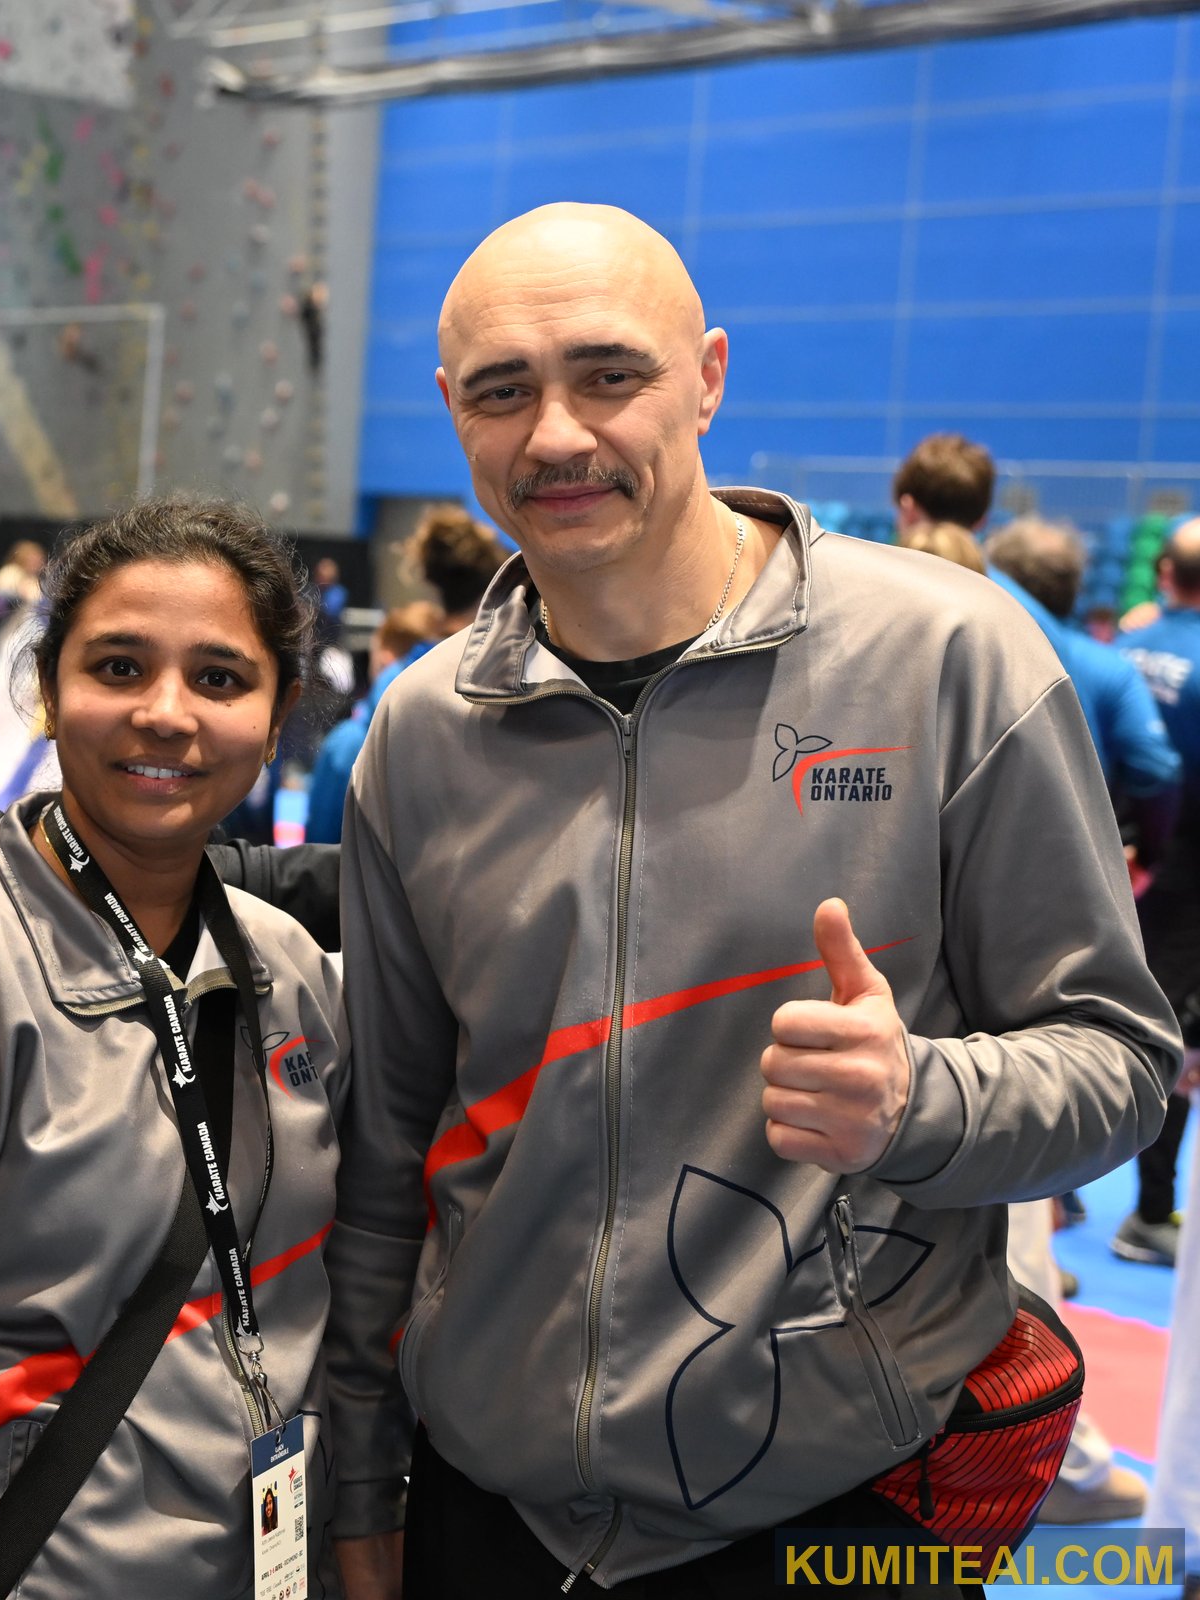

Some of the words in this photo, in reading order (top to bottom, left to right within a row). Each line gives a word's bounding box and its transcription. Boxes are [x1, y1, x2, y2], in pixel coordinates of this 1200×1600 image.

[810, 784, 892, 802] ONTARIO
[811, 767, 886, 785] KARATE
[61, 828, 84, 858] KARATE
[104, 892, 129, 923] CANADA
[124, 923, 150, 952] KARATE
[163, 994, 181, 1034] CANADA
[174, 1034, 192, 1073] KARATE
[197, 1121, 215, 1161] CANADA
[207, 1162, 225, 1200] KARATE
[229, 1247, 244, 1287] CANADA
